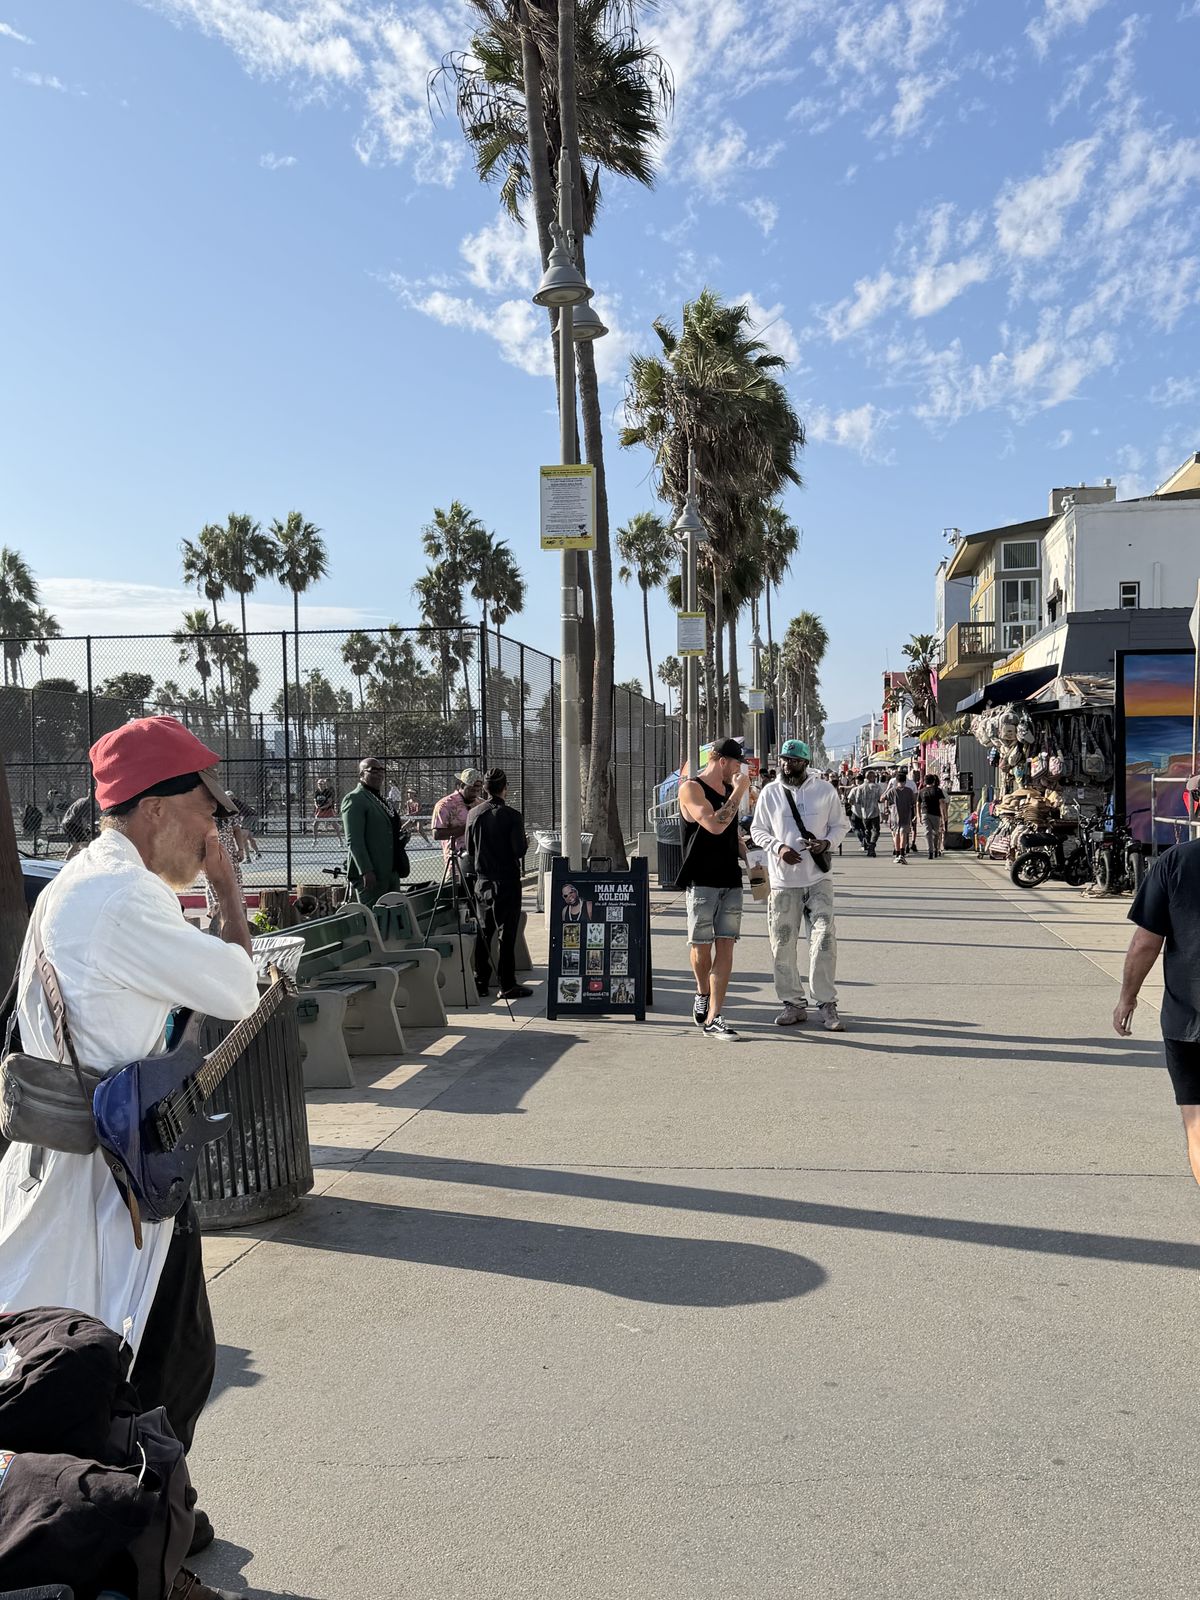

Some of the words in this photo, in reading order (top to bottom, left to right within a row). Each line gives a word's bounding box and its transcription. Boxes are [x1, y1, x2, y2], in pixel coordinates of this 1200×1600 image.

[594, 884, 615, 893] IMAN
[617, 884, 634, 893] AKA
[598, 892, 630, 901] KOLEON
